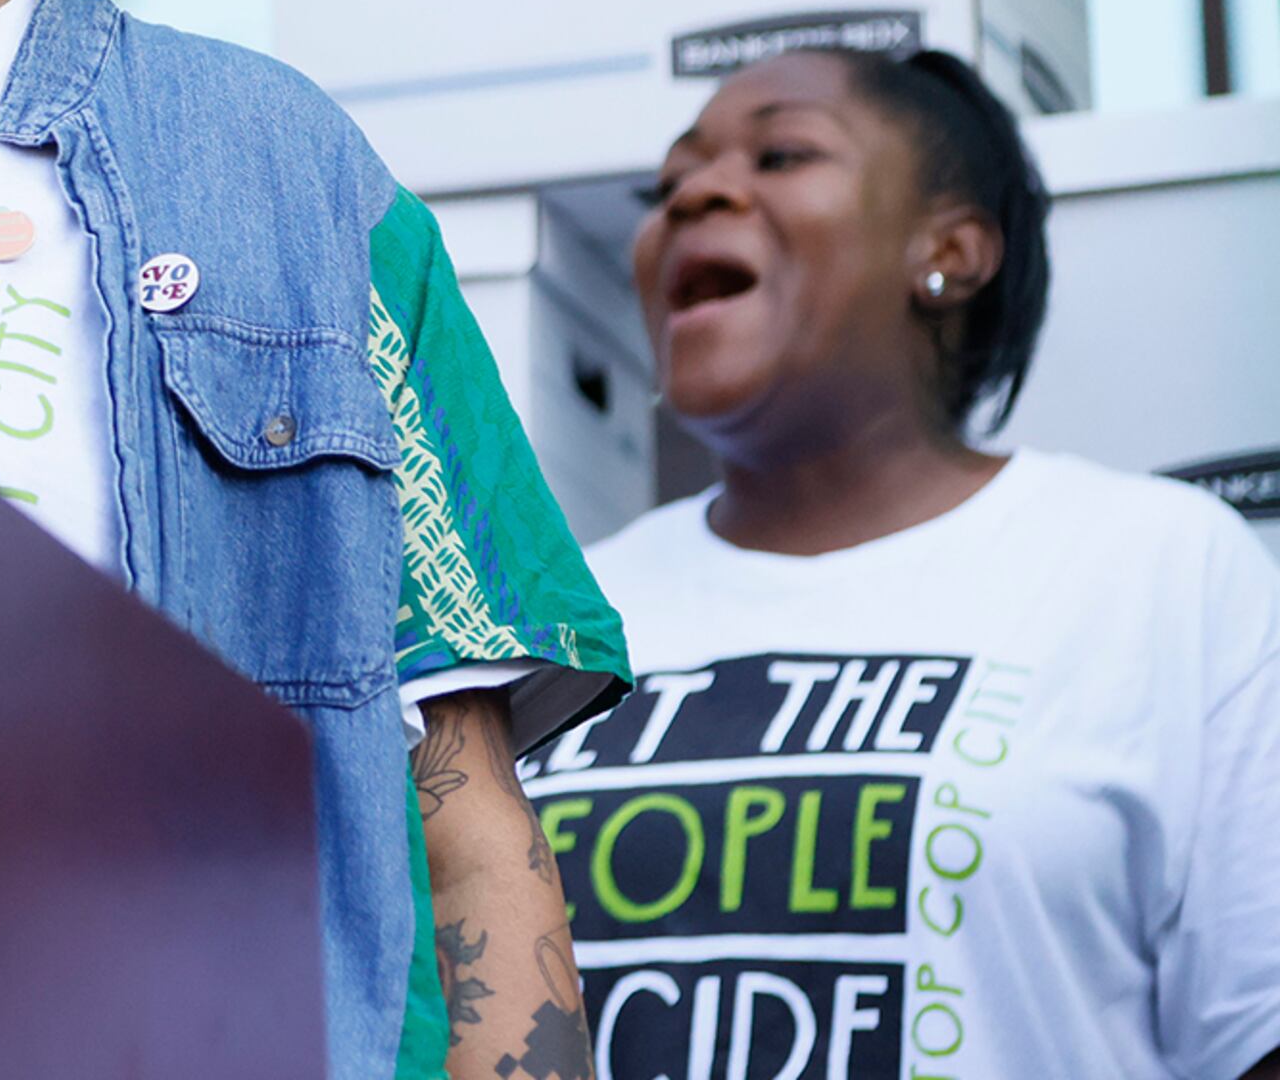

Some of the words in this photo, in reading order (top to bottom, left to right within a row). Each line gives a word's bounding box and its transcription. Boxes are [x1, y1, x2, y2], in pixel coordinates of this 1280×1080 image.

[516, 670, 716, 778] ET
[760, 658, 959, 753] THE
[540, 783, 907, 924] EOPLE
[918, 783, 992, 938] COP
[577, 970, 889, 1080] CIDE
[910, 963, 964, 1080] TOP
